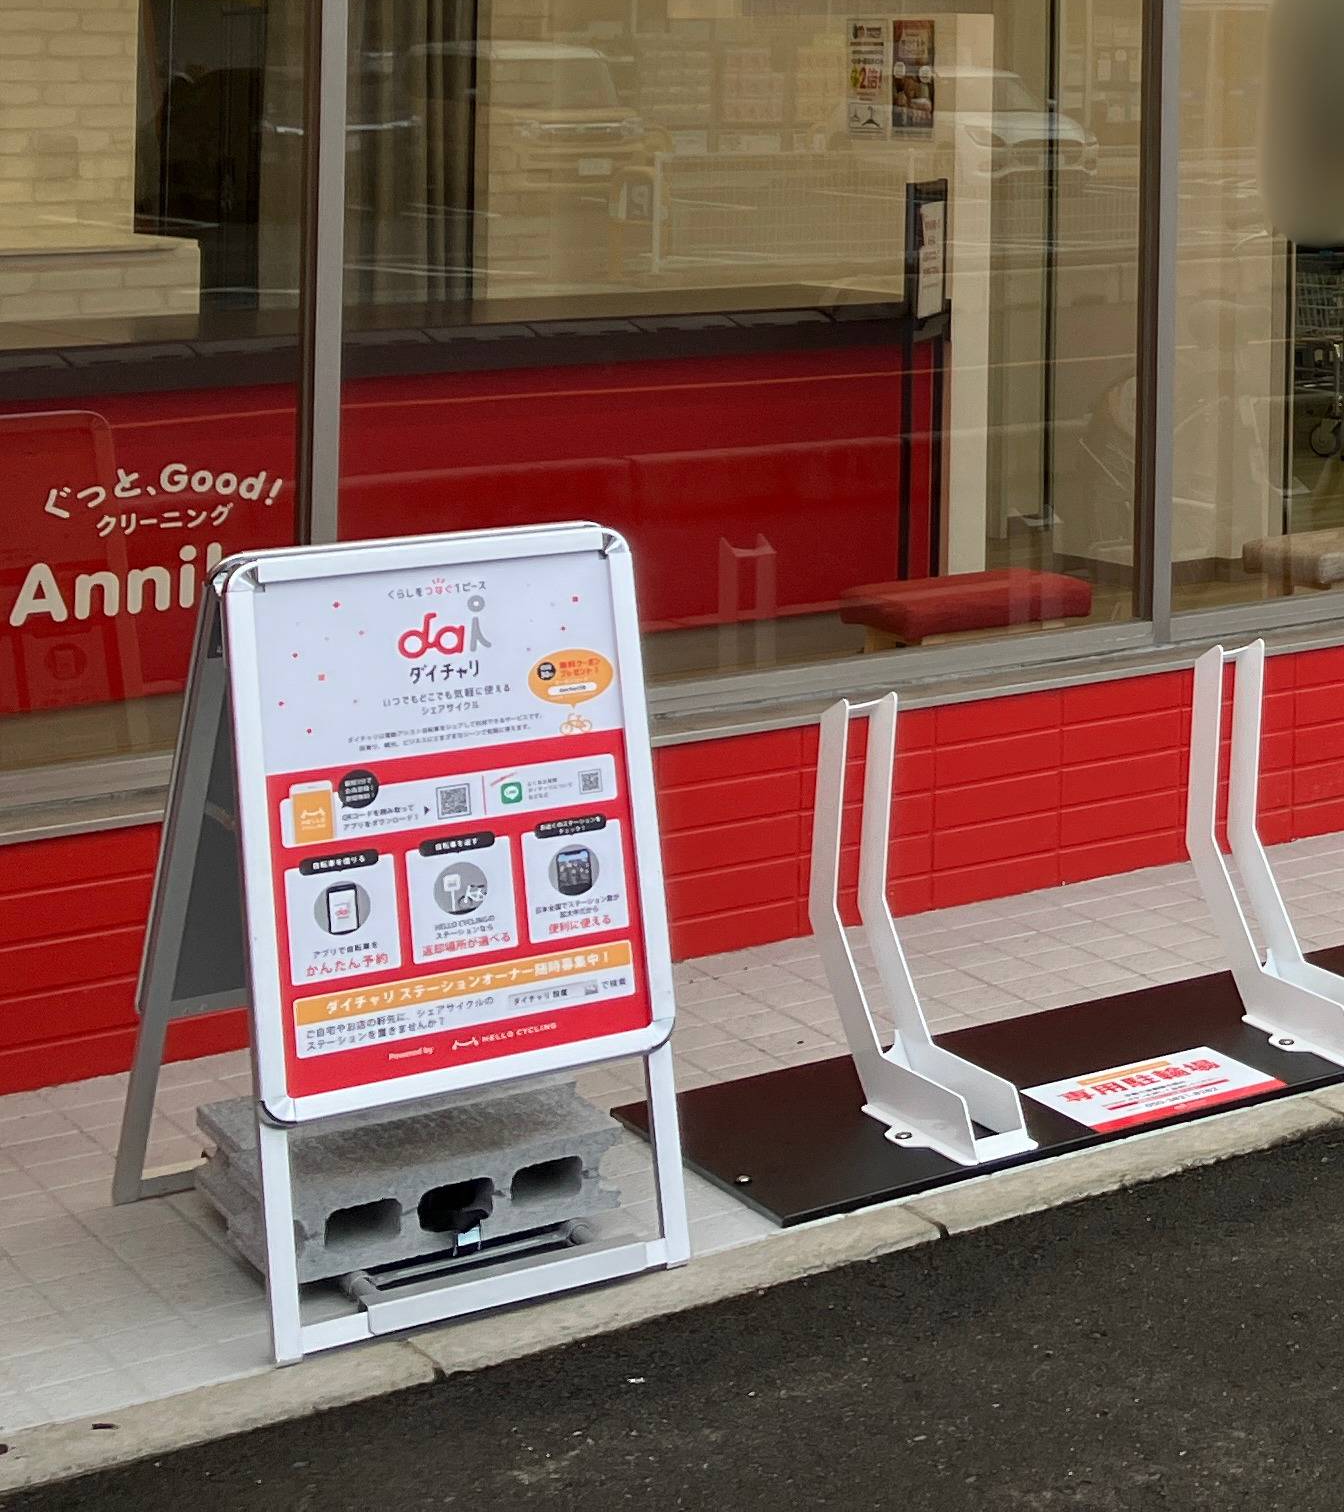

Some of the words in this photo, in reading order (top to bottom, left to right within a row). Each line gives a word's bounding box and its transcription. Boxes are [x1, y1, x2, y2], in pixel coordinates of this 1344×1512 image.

[96, 502, 235, 537] クリーニング
[9, 542, 223, 627] Anni
[409, 659, 480, 684] ダイチャリ
[383, 683, 511, 708] いつでもどこでも気軽に使える
[421, 701, 480, 716] シェアサイクル
[305, 952, 389, 978] かんたん予約
[325, 991, 395, 1016] ダイチャリ
